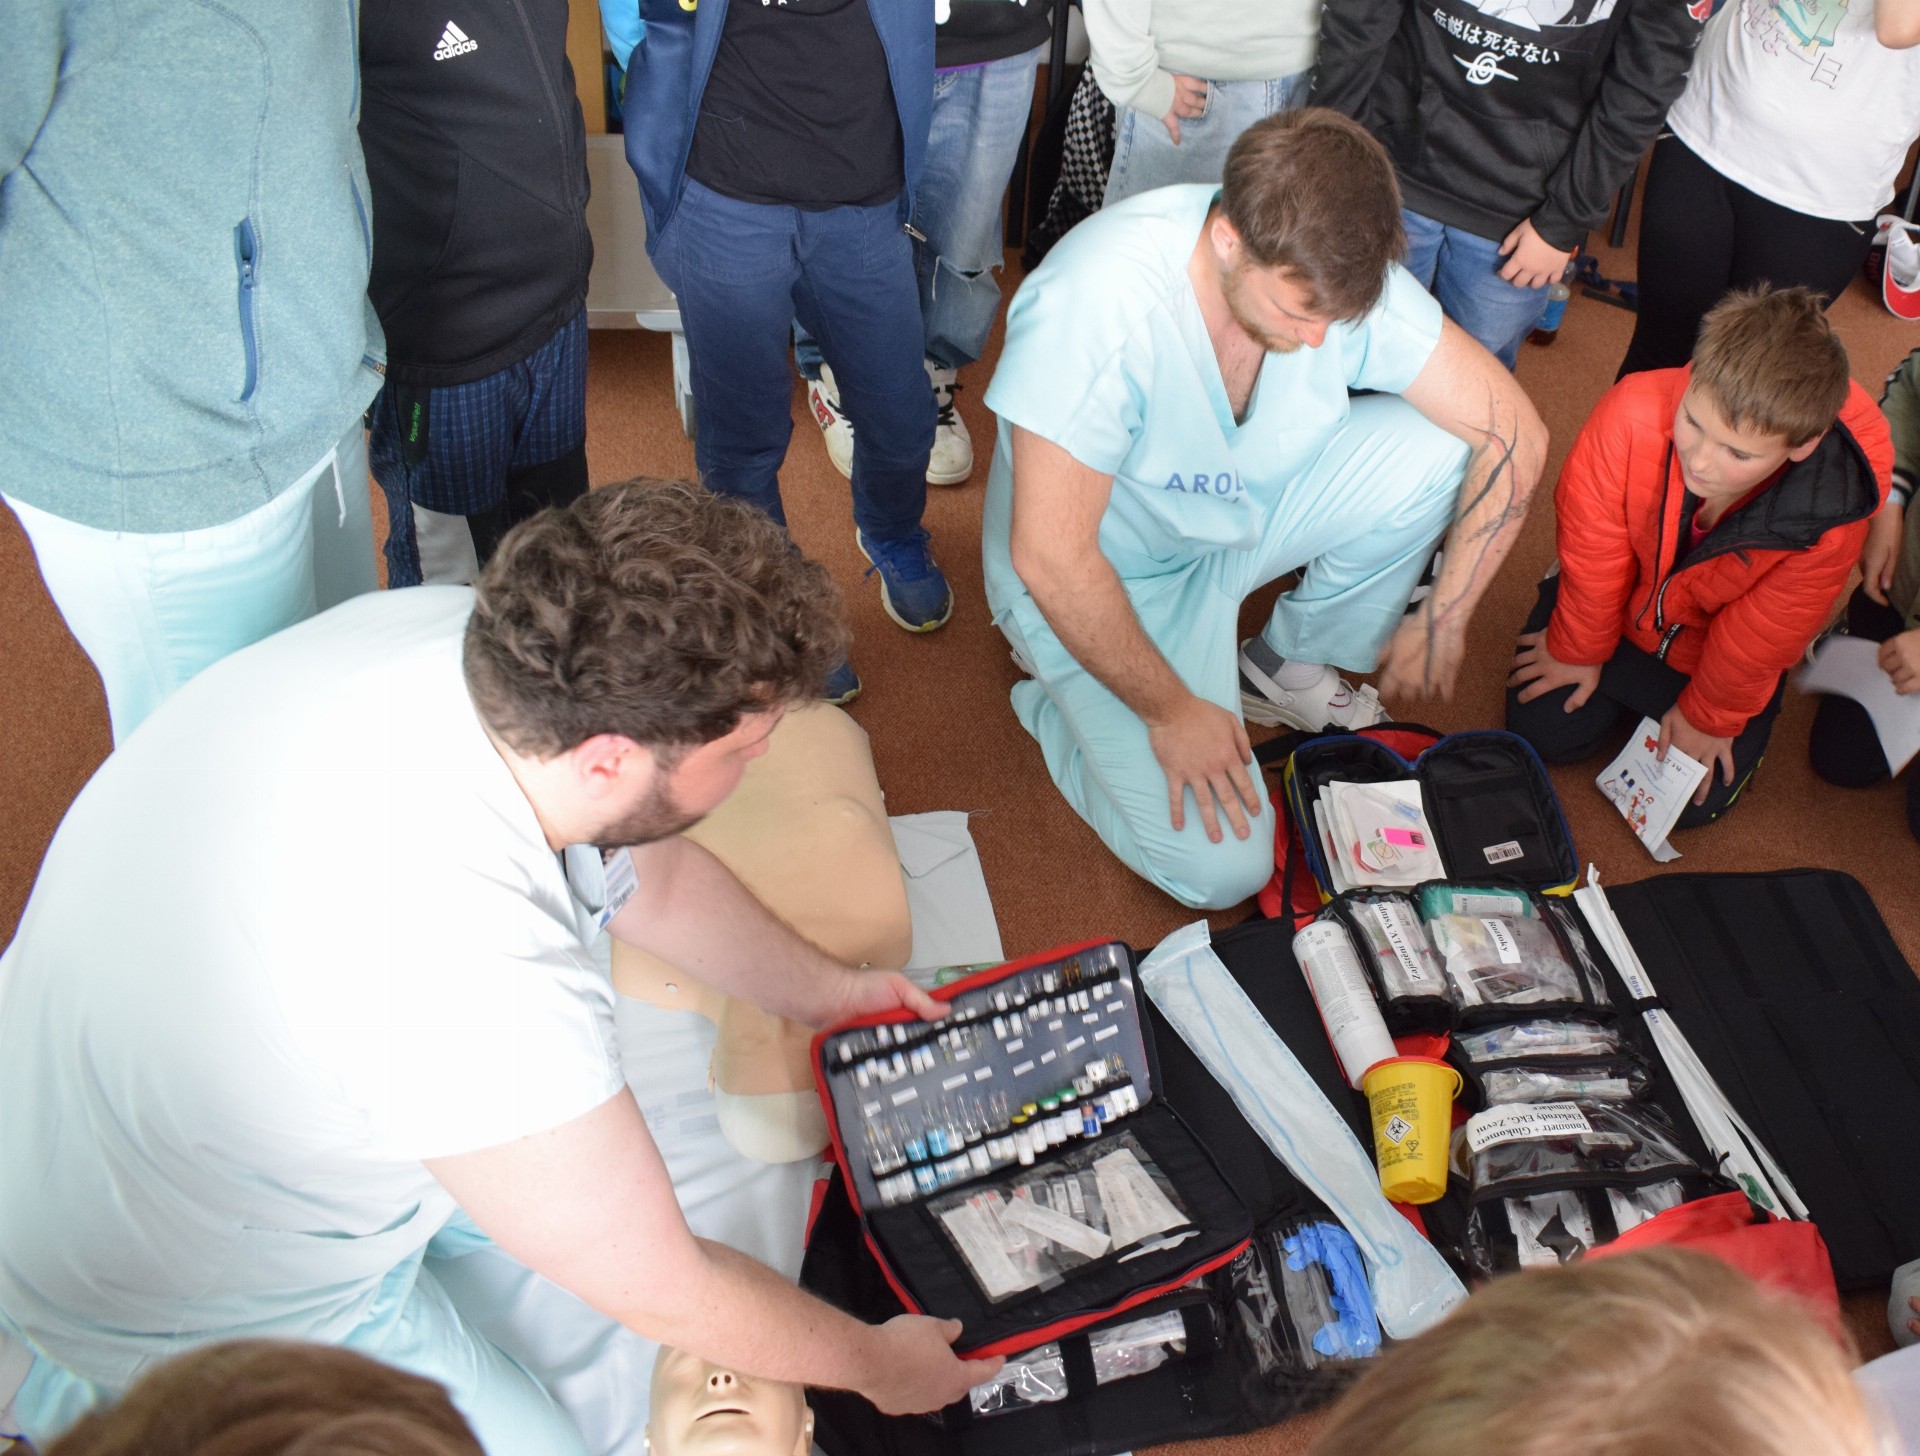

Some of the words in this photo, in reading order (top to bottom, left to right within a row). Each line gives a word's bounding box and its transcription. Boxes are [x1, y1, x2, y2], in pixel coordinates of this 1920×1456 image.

[1432, 7, 1560, 65] 伝説は死なない
[433, 39, 478, 61] adidas
[1488, 921, 1509, 953] Roztoky
[1537, 1112, 1583, 1120] Elektrody
[1476, 1119, 1507, 1136] Zevní
[1477, 1126, 1531, 1146] Glukometr
[1543, 1122, 1590, 1132] Tonometr
